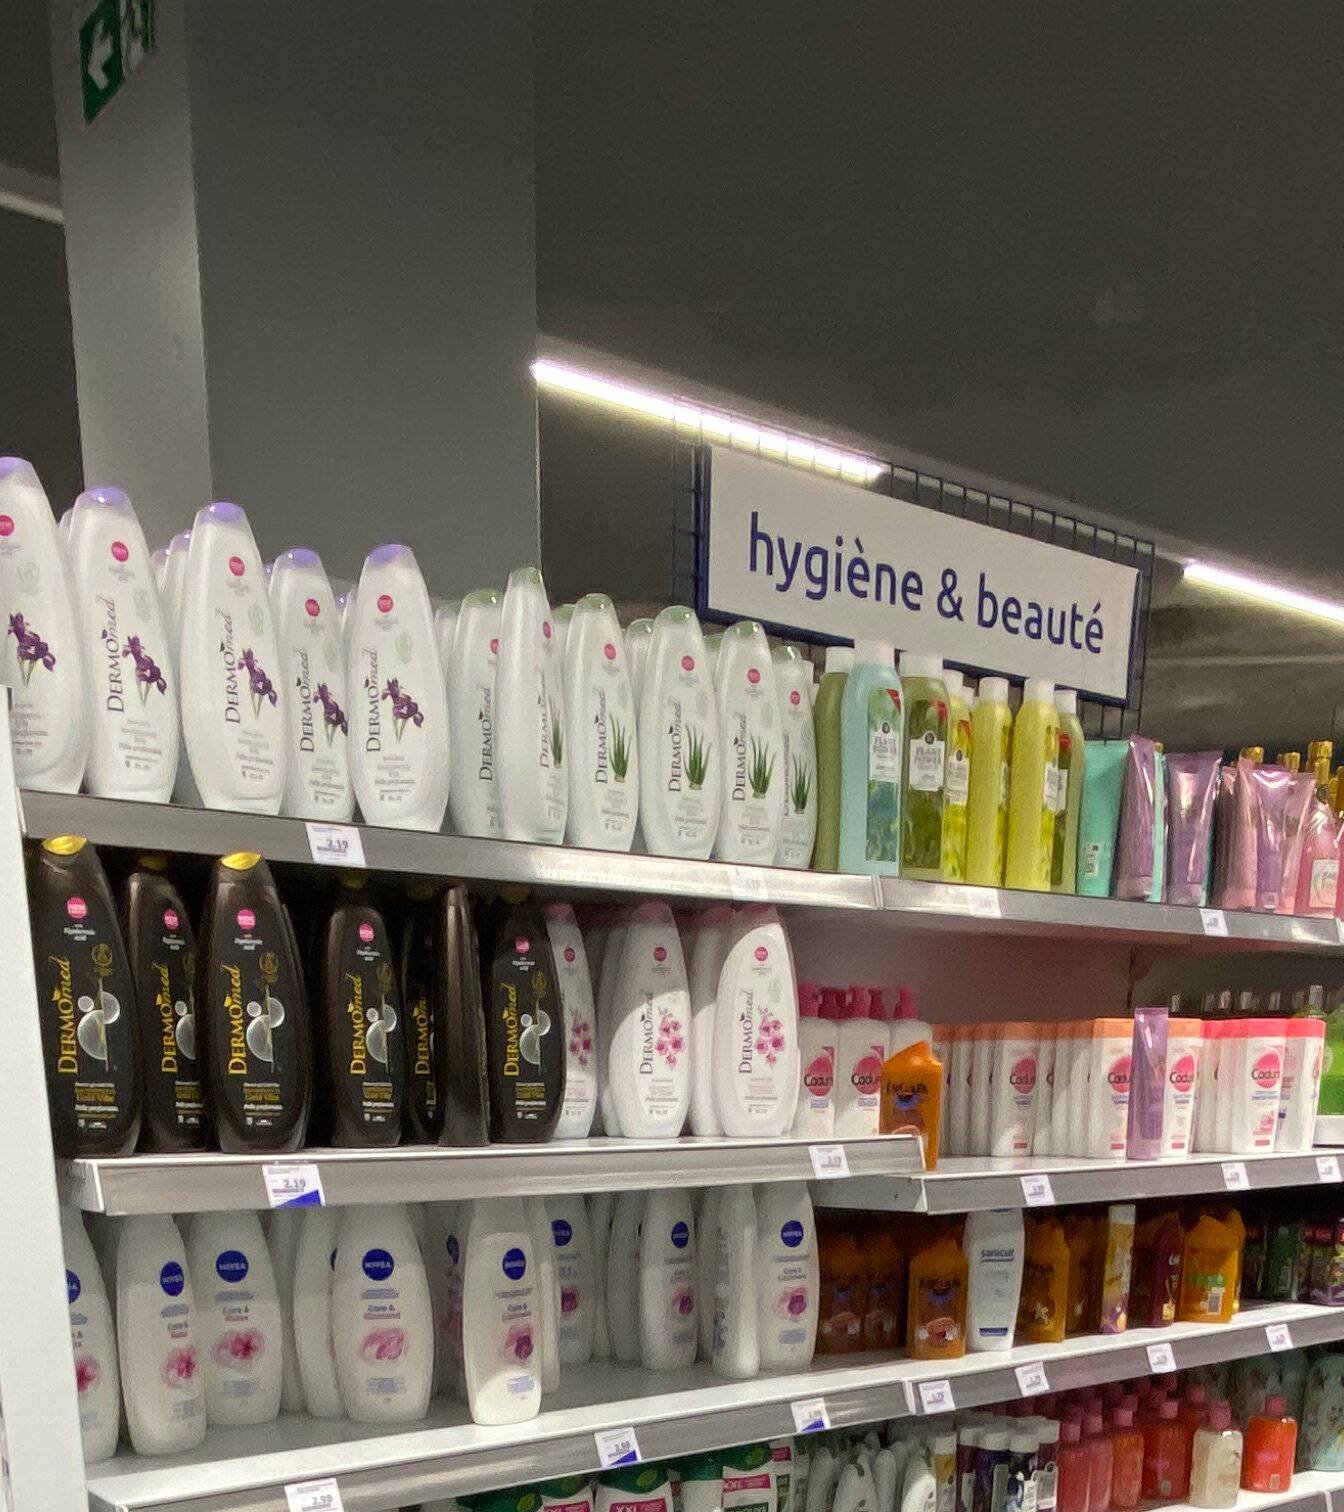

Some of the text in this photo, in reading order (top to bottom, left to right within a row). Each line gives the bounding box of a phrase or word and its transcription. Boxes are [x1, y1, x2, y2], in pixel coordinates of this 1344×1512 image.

[749, 510, 1104, 654] hygiène & beauté
